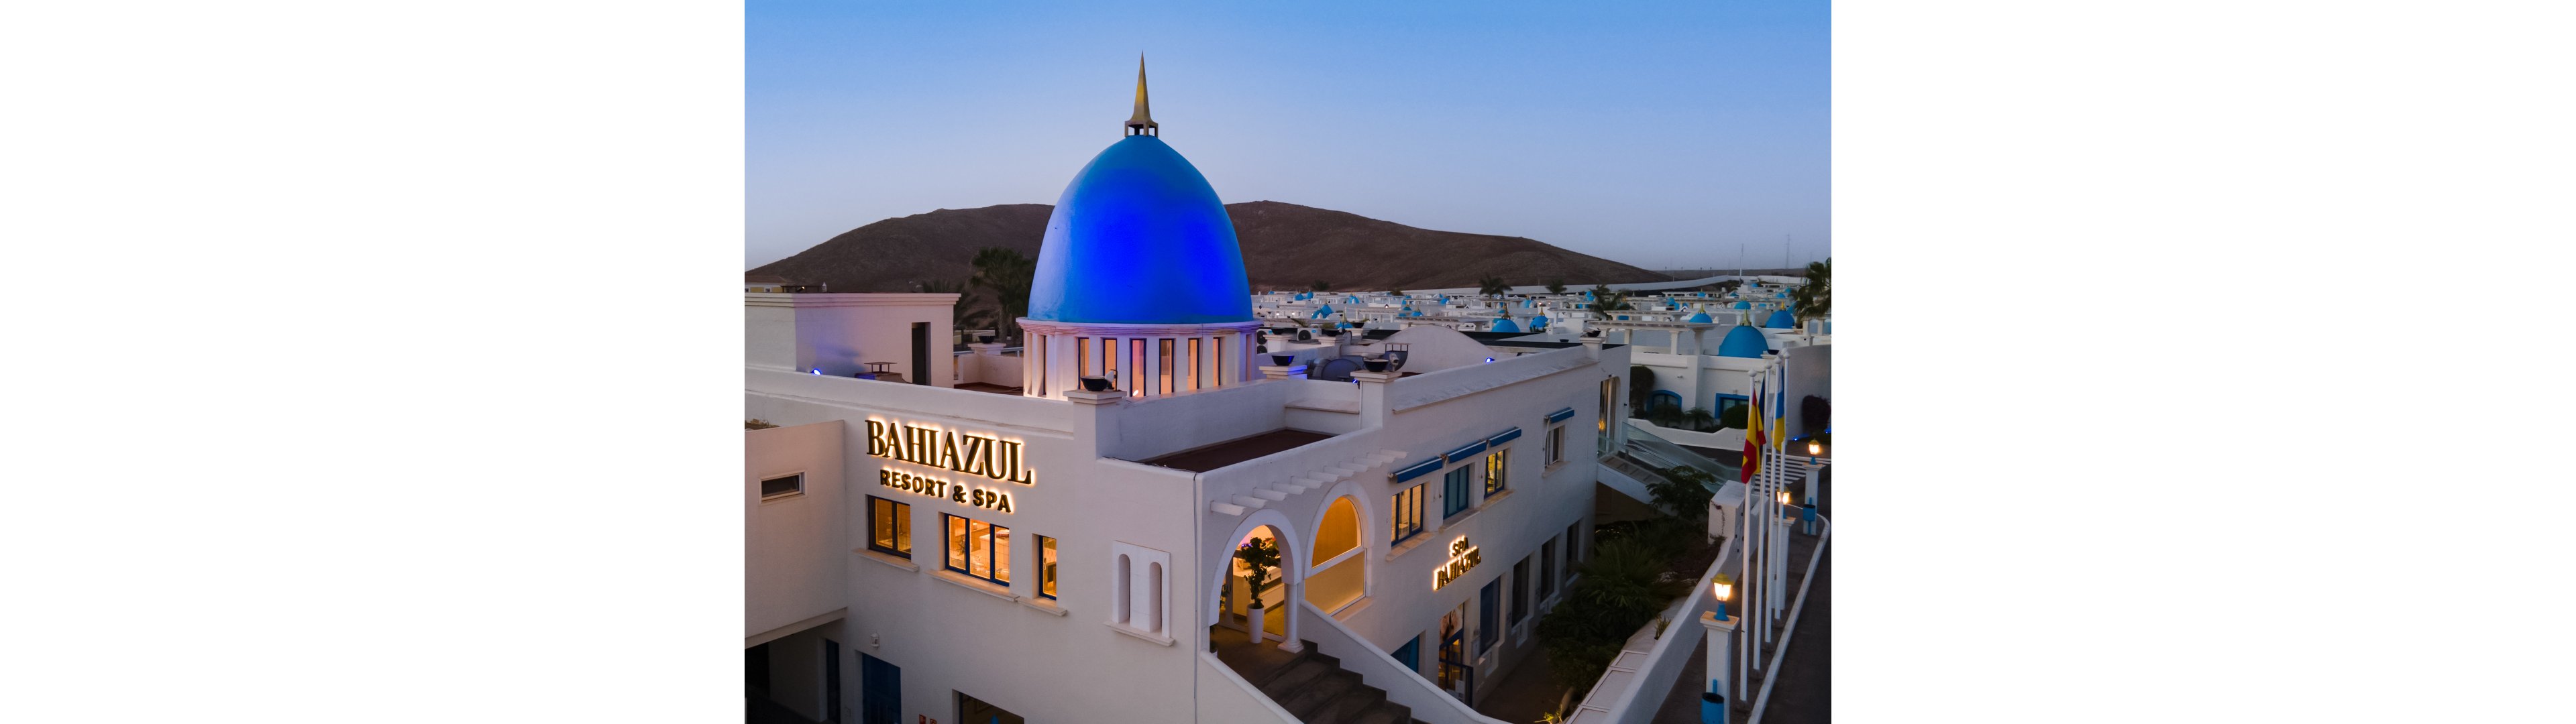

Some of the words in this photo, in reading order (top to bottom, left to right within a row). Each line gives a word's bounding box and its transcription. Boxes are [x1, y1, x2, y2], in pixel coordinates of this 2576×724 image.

[865, 419, 1032, 484] BAHIAZUL
[880, 469, 947, 497] RESORT
[953, 485, 966, 503] &
[973, 489, 1011, 513] SPA
[1452, 536, 1469, 556] SPA
